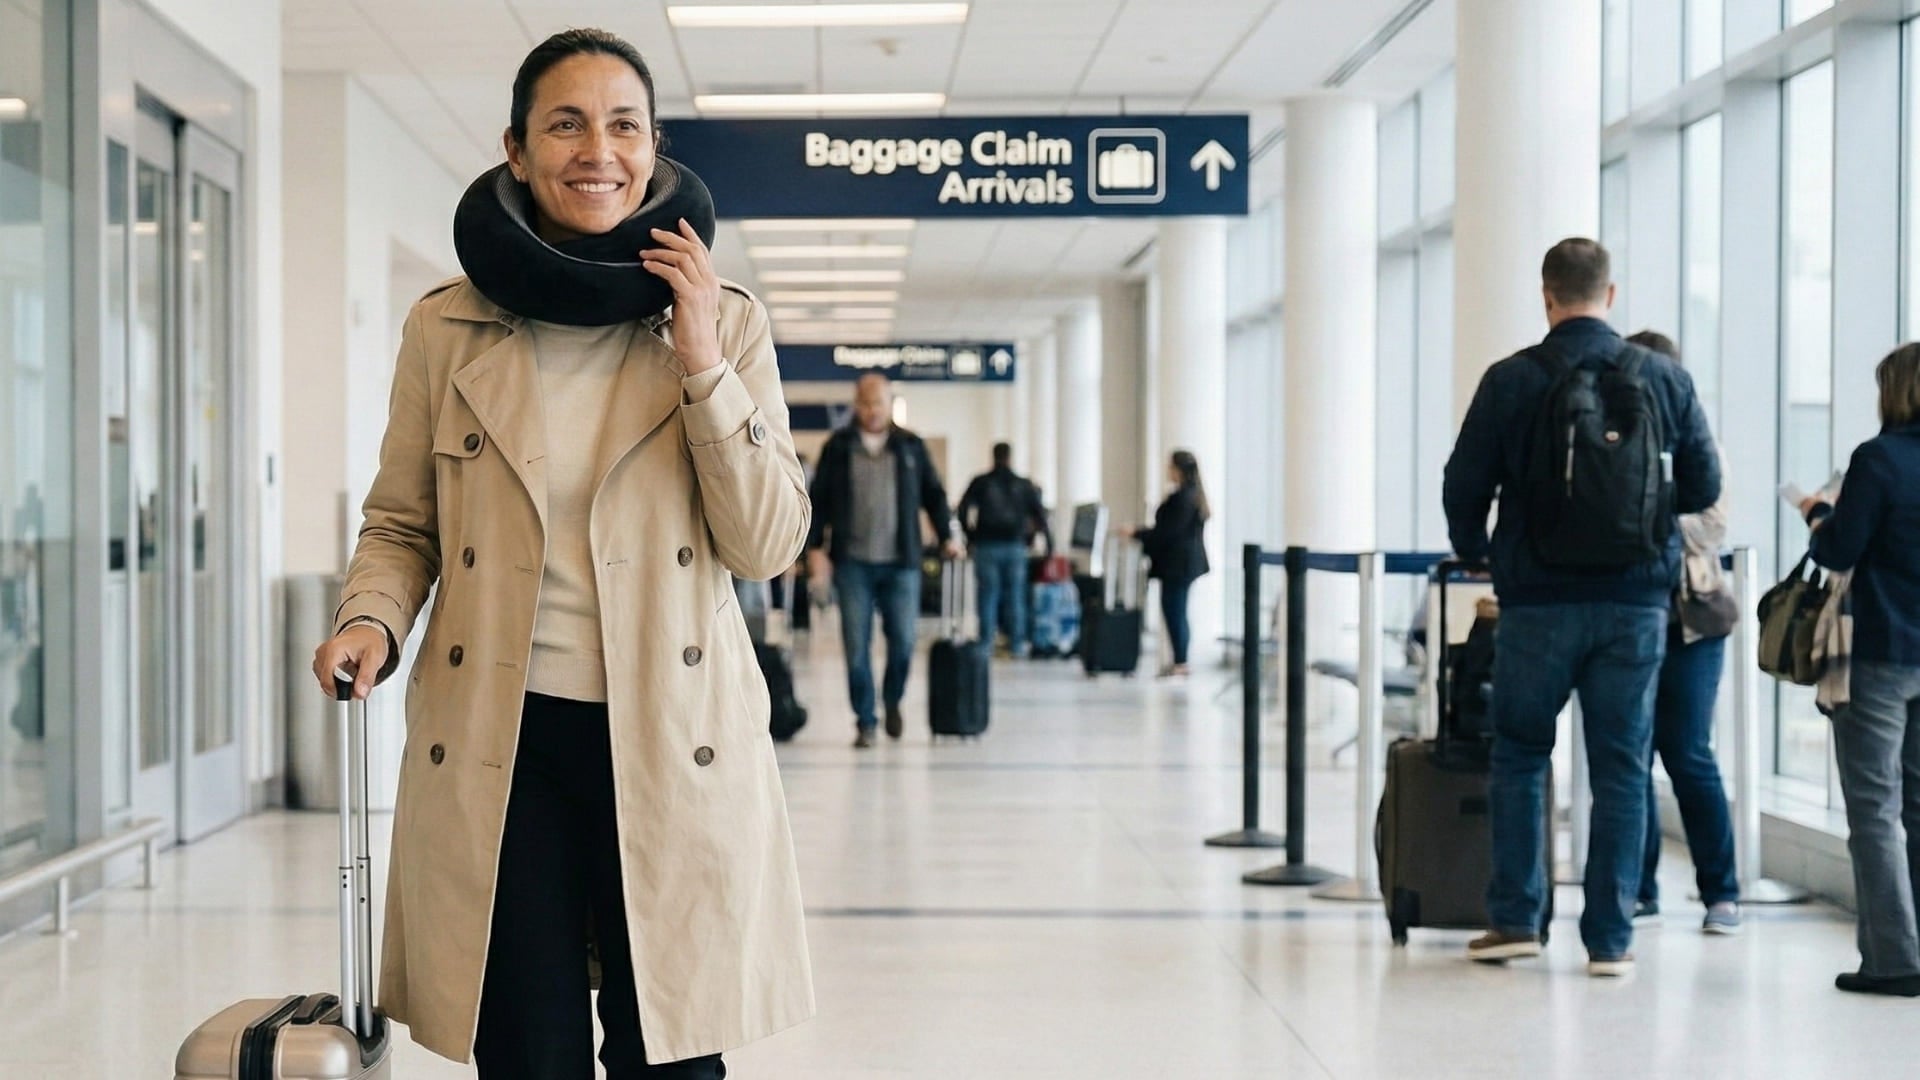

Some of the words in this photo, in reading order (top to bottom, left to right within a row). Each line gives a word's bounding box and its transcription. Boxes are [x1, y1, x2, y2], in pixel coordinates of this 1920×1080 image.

[805, 132, 963, 175] Baggage
[970, 131, 1072, 165] Claim
[938, 170, 1074, 204] Arrivals
